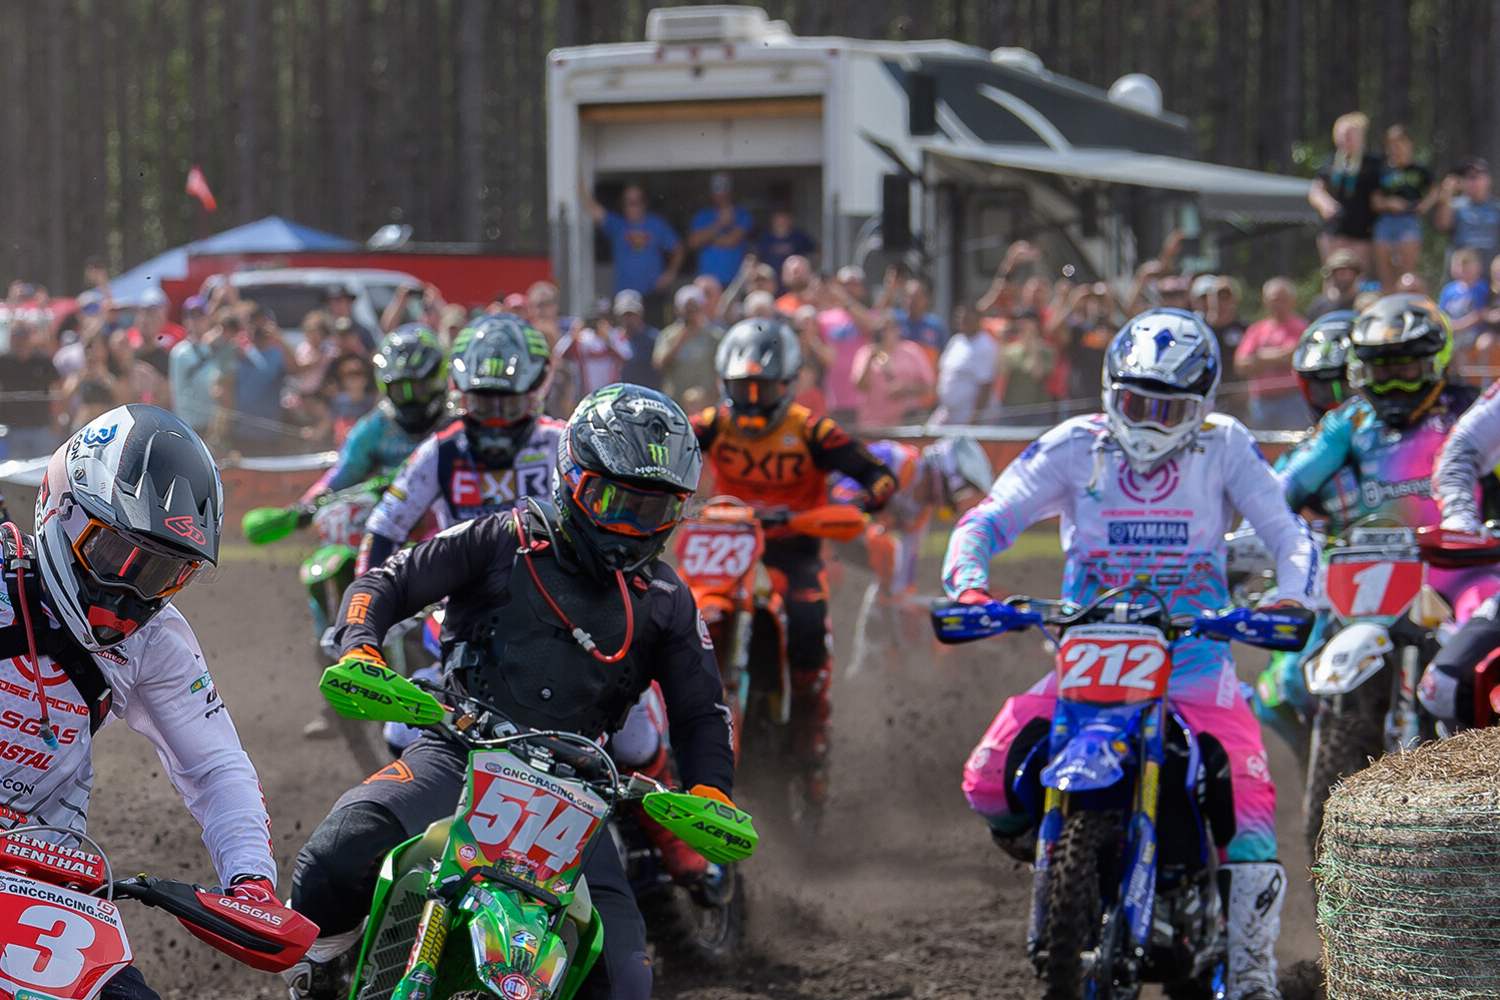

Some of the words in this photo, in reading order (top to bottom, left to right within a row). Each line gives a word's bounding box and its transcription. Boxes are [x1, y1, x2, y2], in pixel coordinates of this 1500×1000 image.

[453, 468, 548, 505] FXR
[1127, 523, 1187, 540] YAMAHA
[684, 533, 756, 577] 523
[1349, 562, 1395, 616] 1
[350, 661, 398, 682] ASV
[1060, 642, 1167, 692] 212
[502, 766, 595, 813] GNCCRACING.COM
[467, 776, 596, 873] 514
[703, 800, 749, 825] ASV
[5, 832, 100, 866] RENTHAL
[691, 820, 753, 850] ACERBIS
[4, 842, 99, 879] RENTHAL
[8, 884, 119, 927] GNCCRACING.COM
[217, 896, 283, 927] GASGAS
[0, 903, 97, 989] 3
